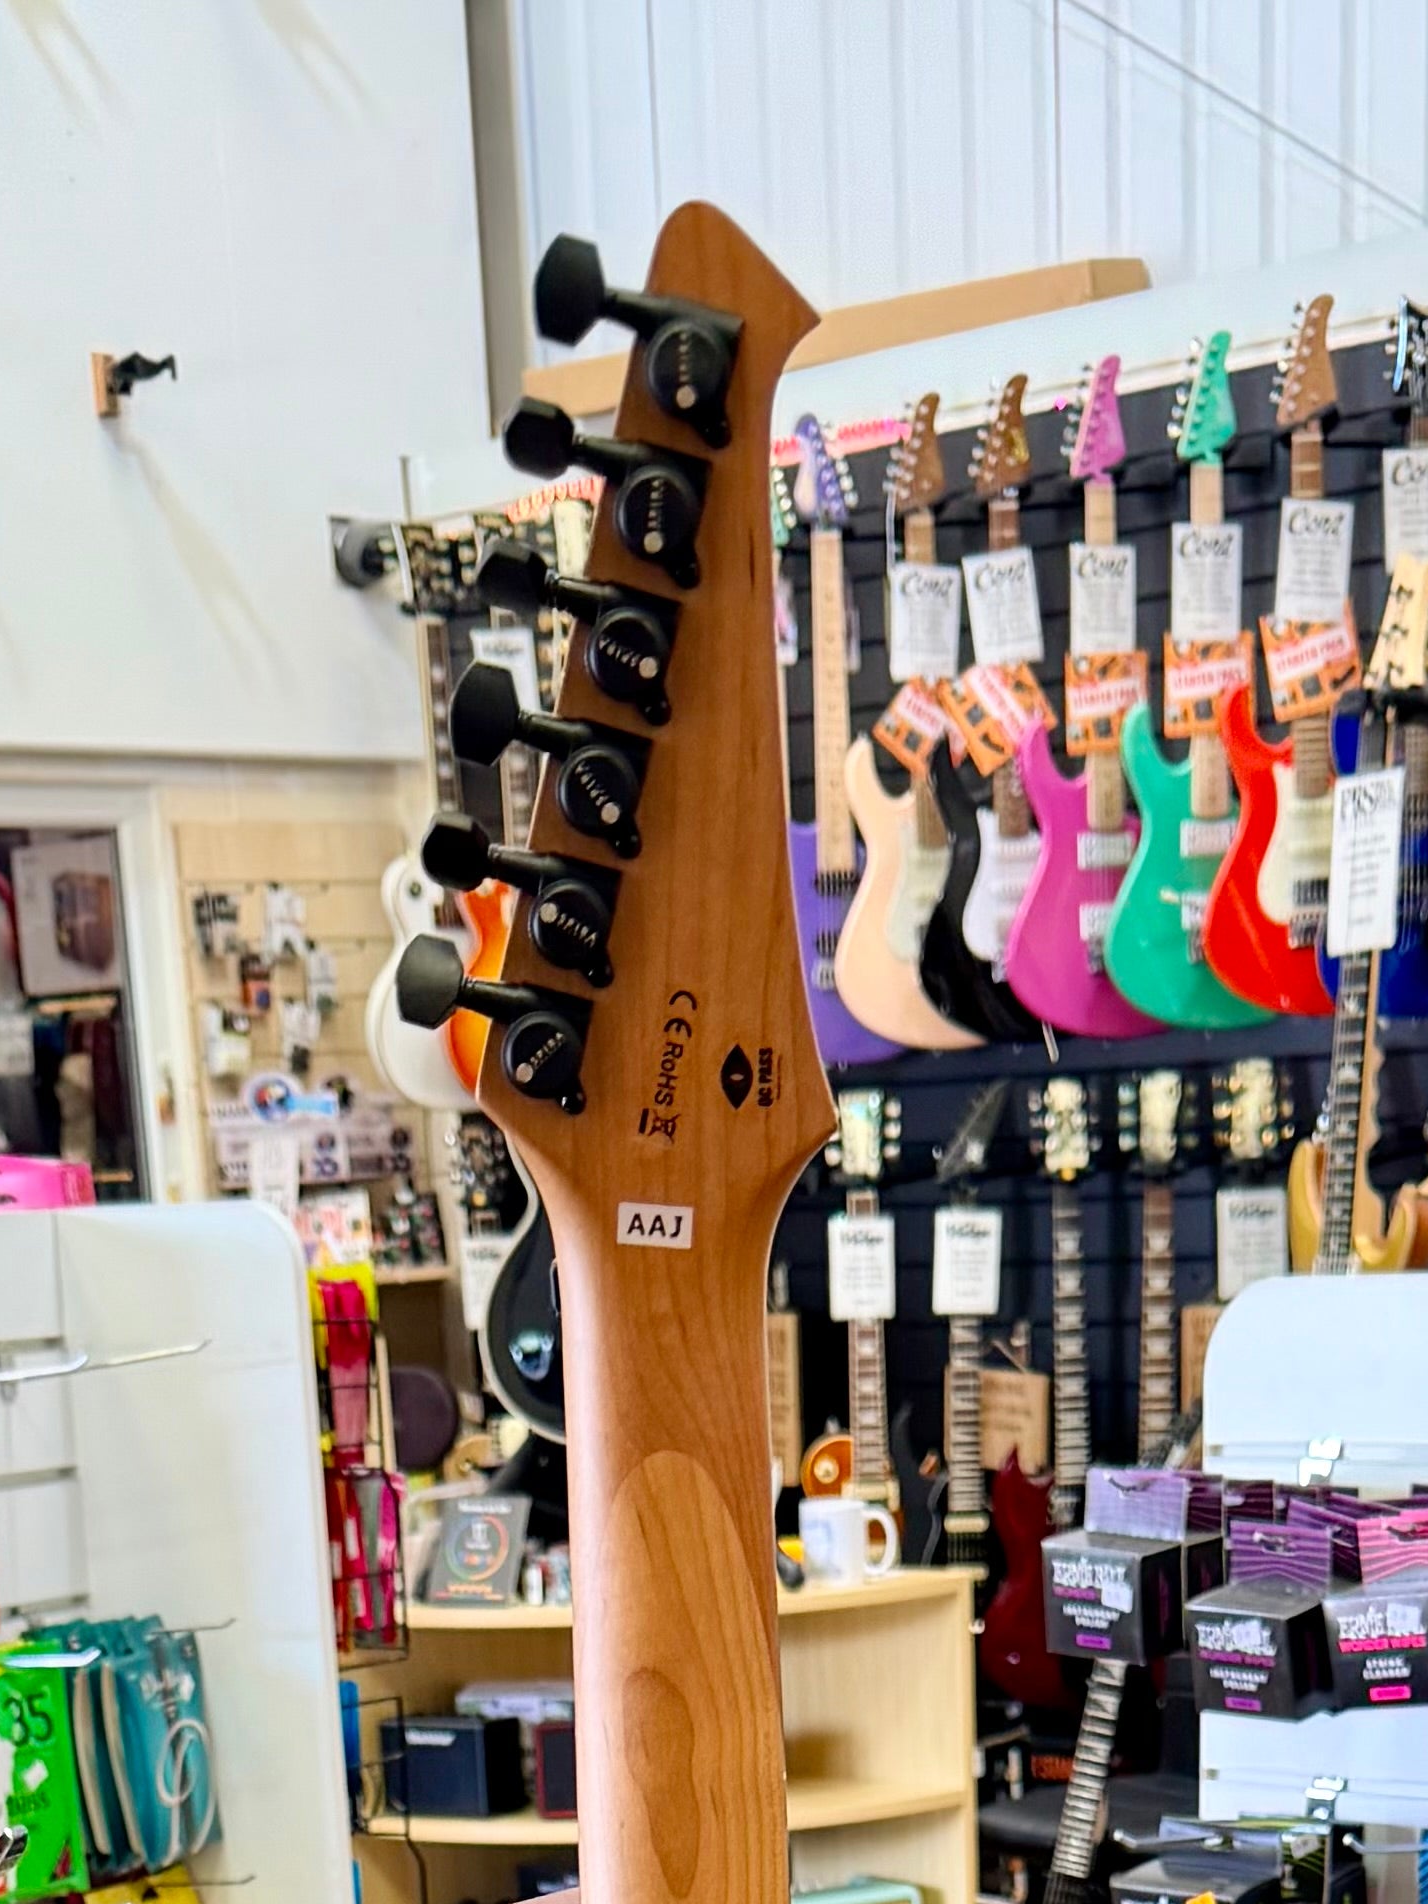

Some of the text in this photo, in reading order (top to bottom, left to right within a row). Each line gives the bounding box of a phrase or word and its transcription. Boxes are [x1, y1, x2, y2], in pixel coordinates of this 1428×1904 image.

[627, 1213, 684, 1239] AAJ
[1338, 1634, 1427, 1654] WONDER WIPES
[2, 1697, 54, 1748] 35
